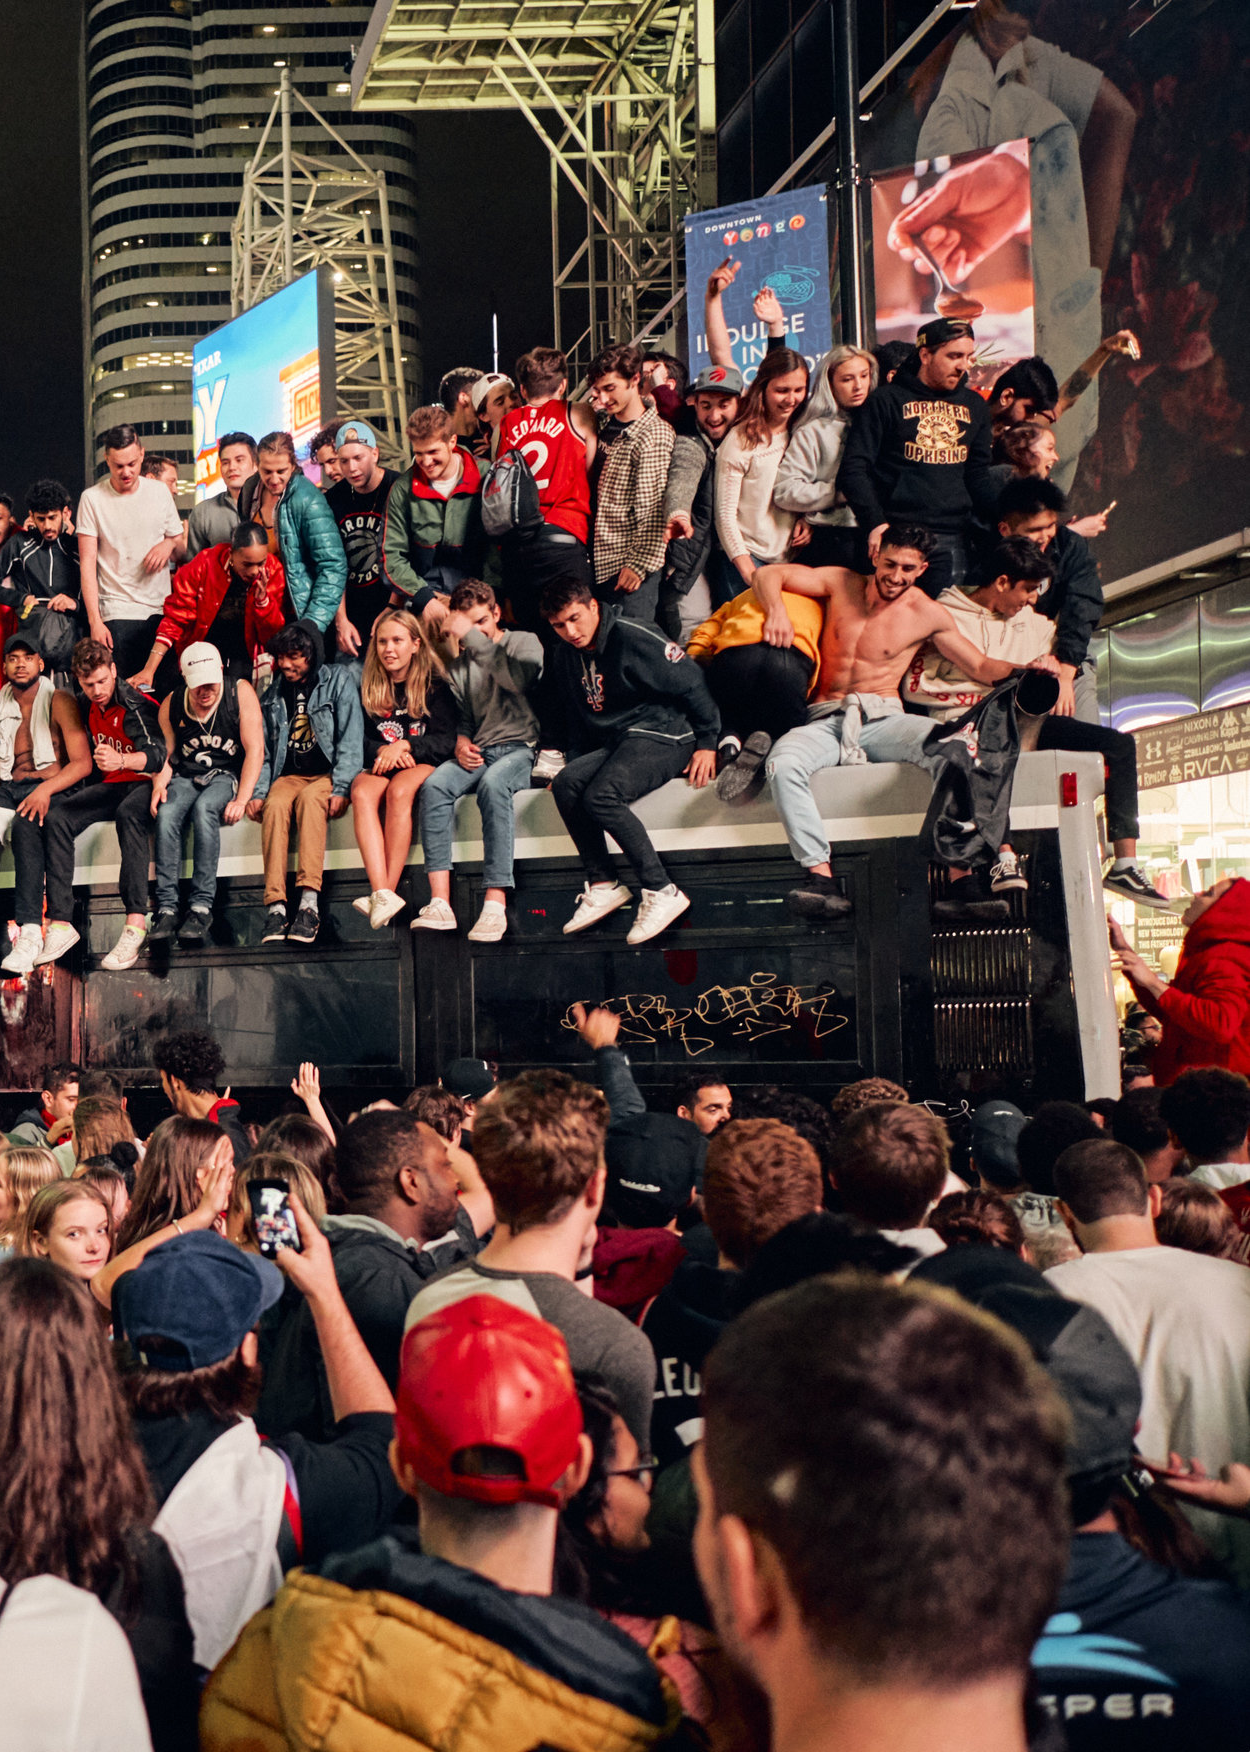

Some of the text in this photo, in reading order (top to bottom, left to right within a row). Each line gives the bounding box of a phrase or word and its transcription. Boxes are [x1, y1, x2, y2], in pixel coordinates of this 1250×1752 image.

[705, 215, 762, 234] DOWNTOWN
[742, 342, 768, 365] IN
[903, 401, 971, 424] NORTHERN
[520, 440, 549, 490] 2
[1184, 717, 1211, 732] NIXON
[195, 750, 212, 768] 6
[1184, 754, 1233, 780] RVCA
